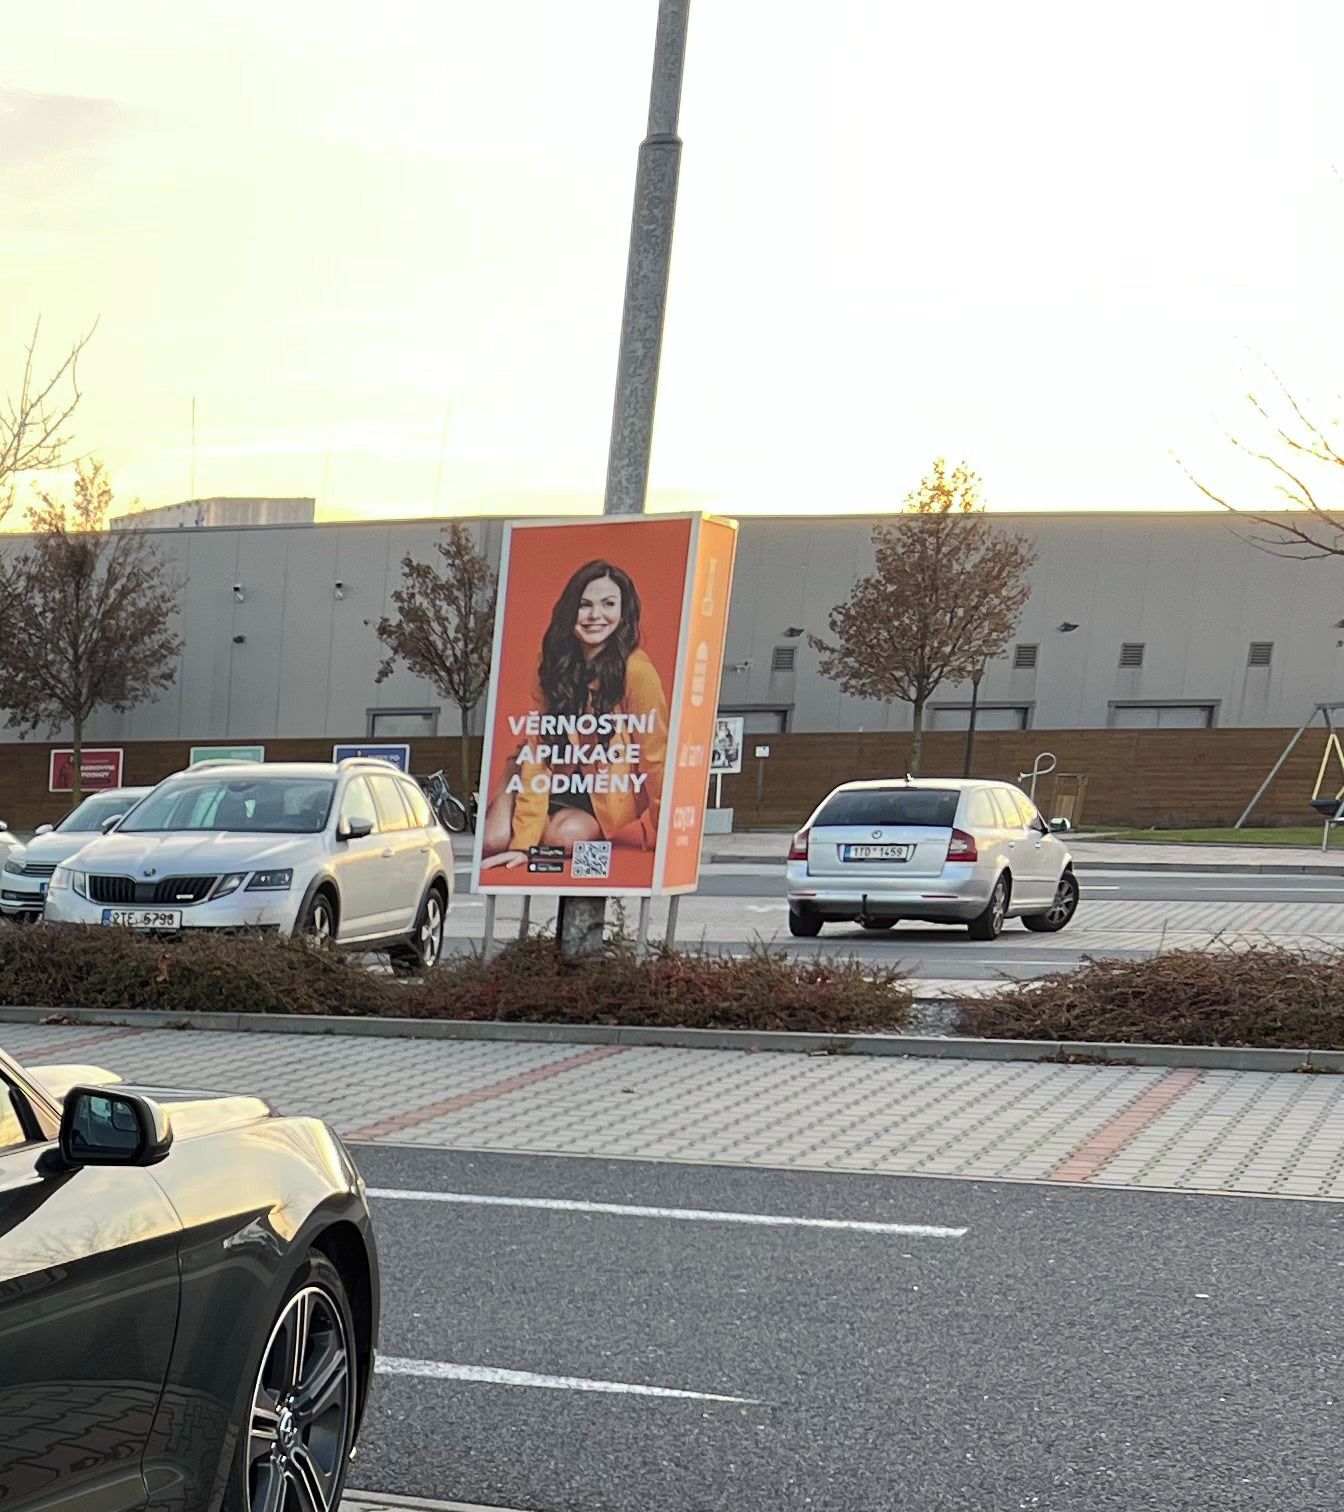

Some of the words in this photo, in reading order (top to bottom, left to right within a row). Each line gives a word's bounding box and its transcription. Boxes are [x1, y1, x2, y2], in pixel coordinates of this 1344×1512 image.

[507, 708, 657, 735] VĚRNOSTNÍ
[515, 743, 641, 766] APLIKACE
[505, 774, 524, 794] A
[530, 768, 648, 794] ODMĚNY
